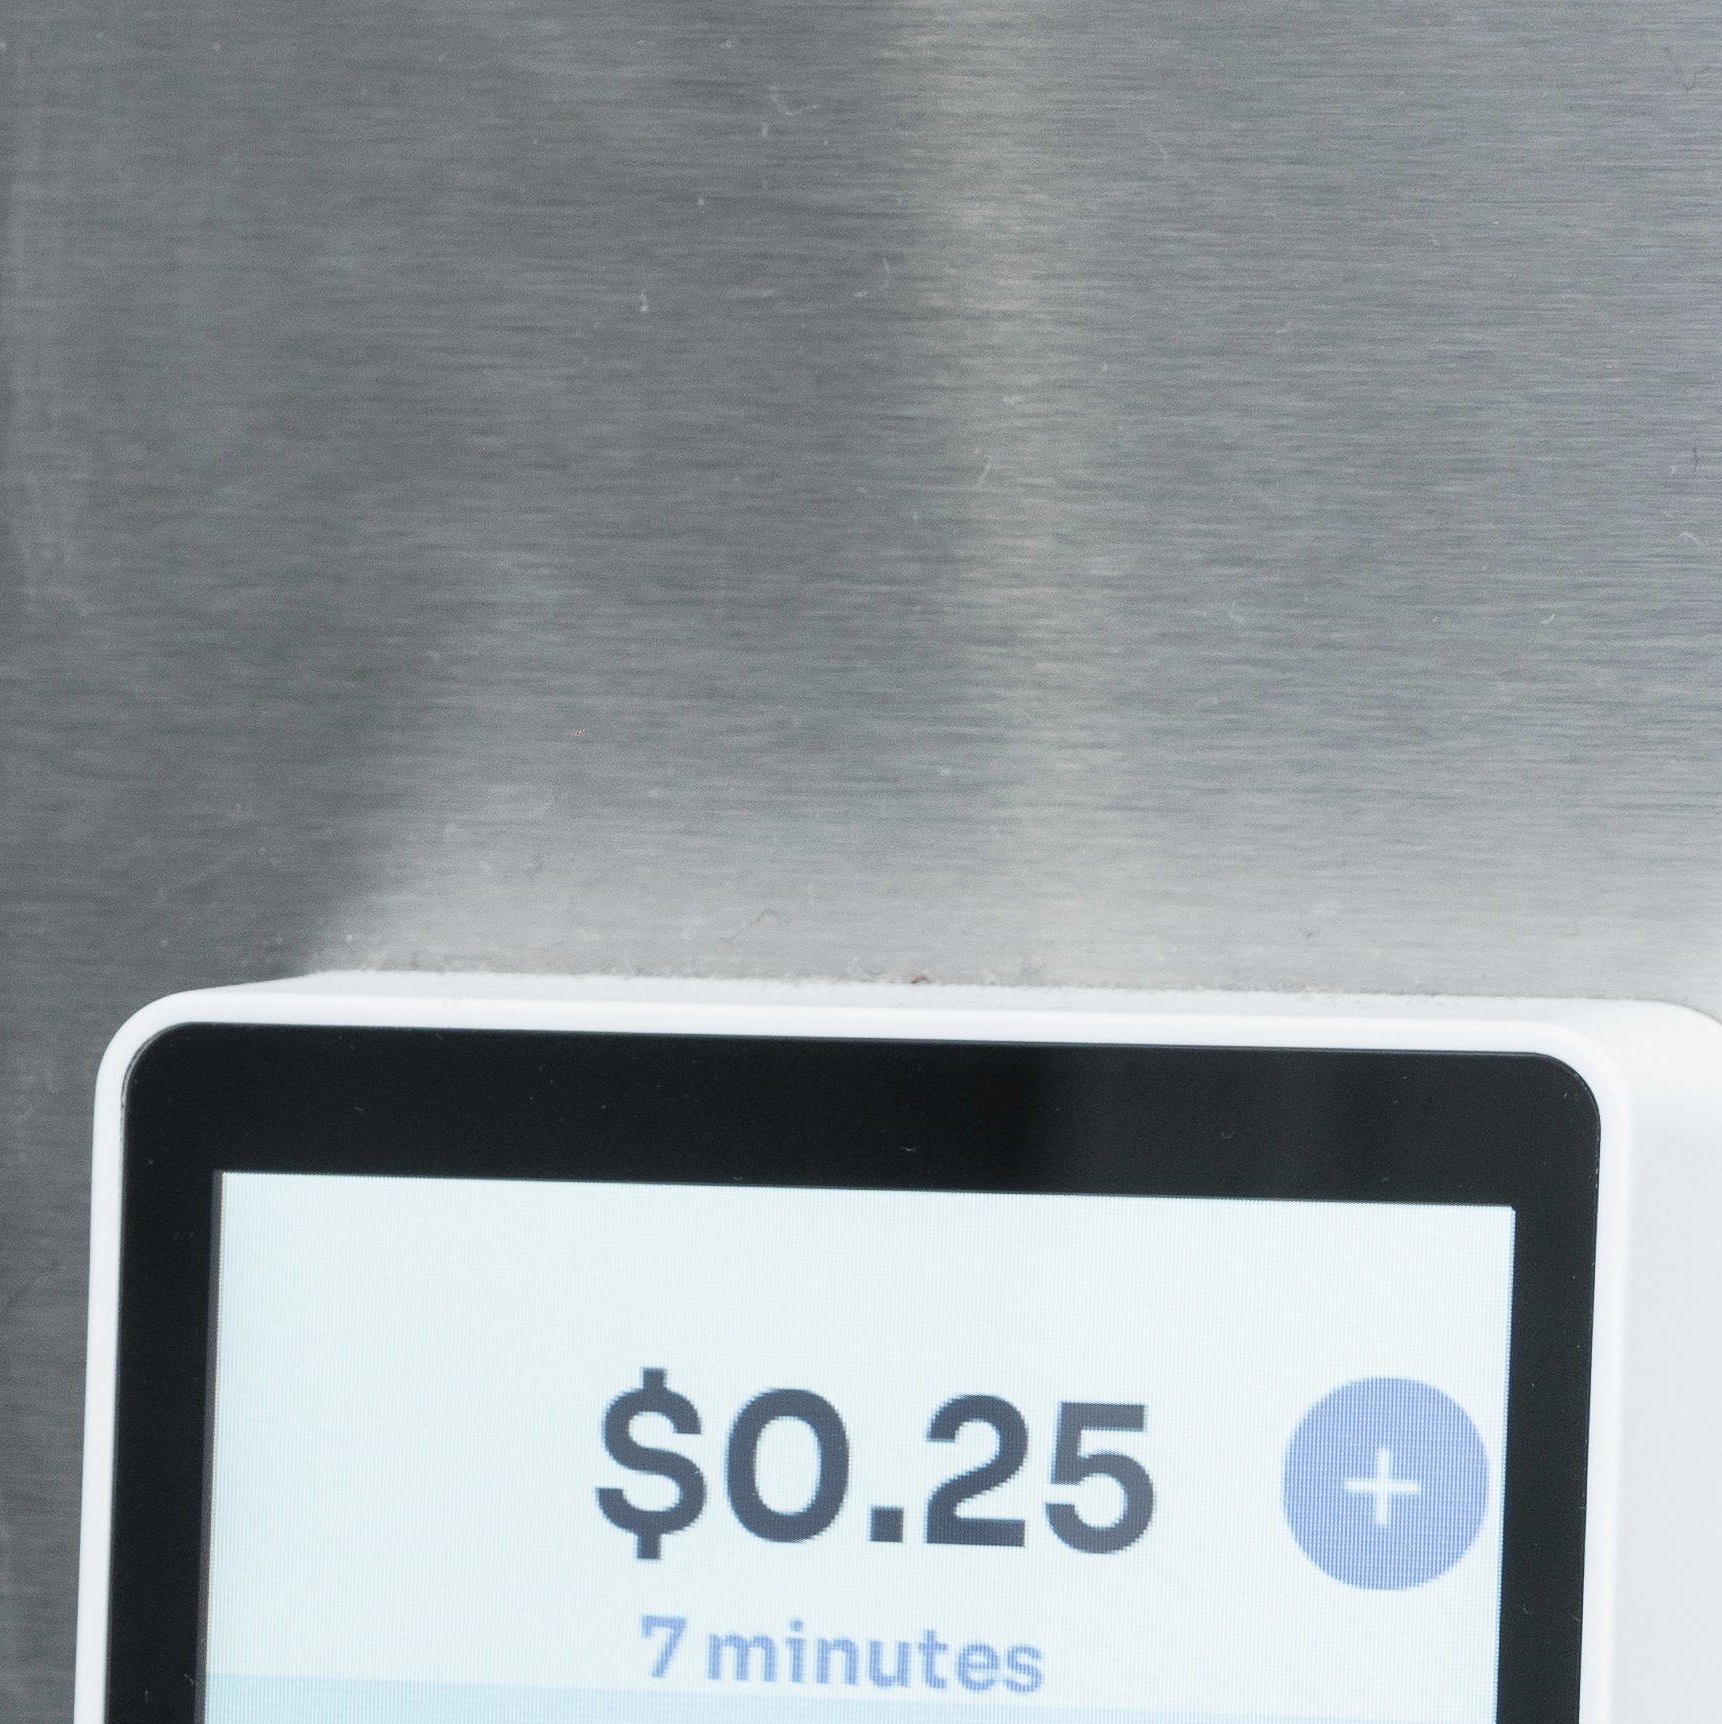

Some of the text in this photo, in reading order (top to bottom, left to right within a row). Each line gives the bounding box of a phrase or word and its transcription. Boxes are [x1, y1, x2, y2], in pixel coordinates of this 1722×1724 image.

[595, 1367, 1155, 1561] $0.25
[639, 1613, 1044, 1695] 7 minutes
